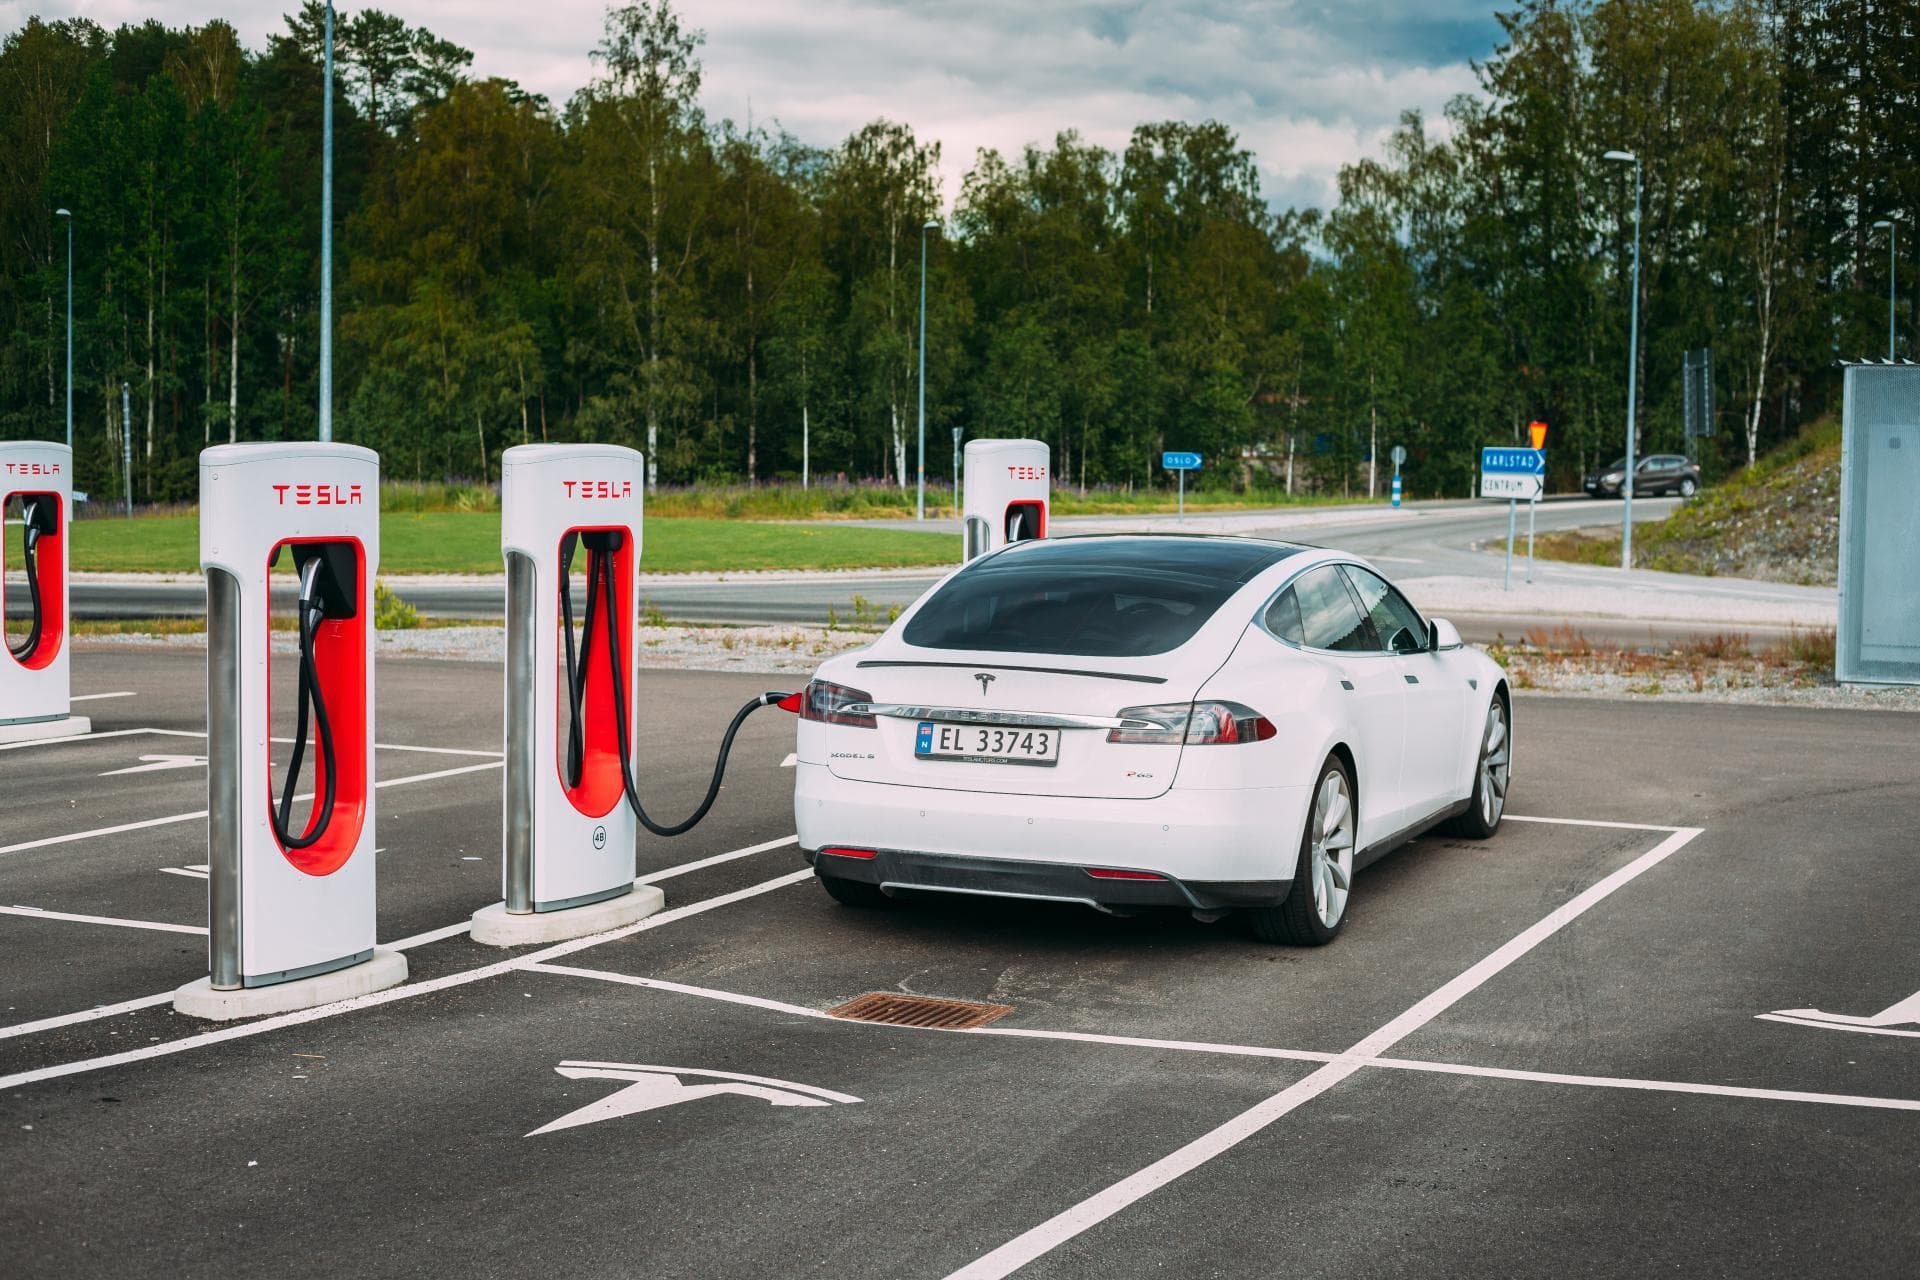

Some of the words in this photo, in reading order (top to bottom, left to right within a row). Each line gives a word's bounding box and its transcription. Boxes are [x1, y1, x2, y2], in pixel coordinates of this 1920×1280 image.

[1167, 456, 1191, 464] OSLO
[1485, 455, 1534, 468] KARLSTAD
[6, 463, 60, 475] TESLA
[1007, 466, 1045, 480] TESLA
[272, 485, 362, 504] TESLA
[562, 481, 631, 498] TESLA
[939, 728, 964, 751] EL
[976, 729, 1049, 755] 33743
[594, 832, 605, 841] 4B
